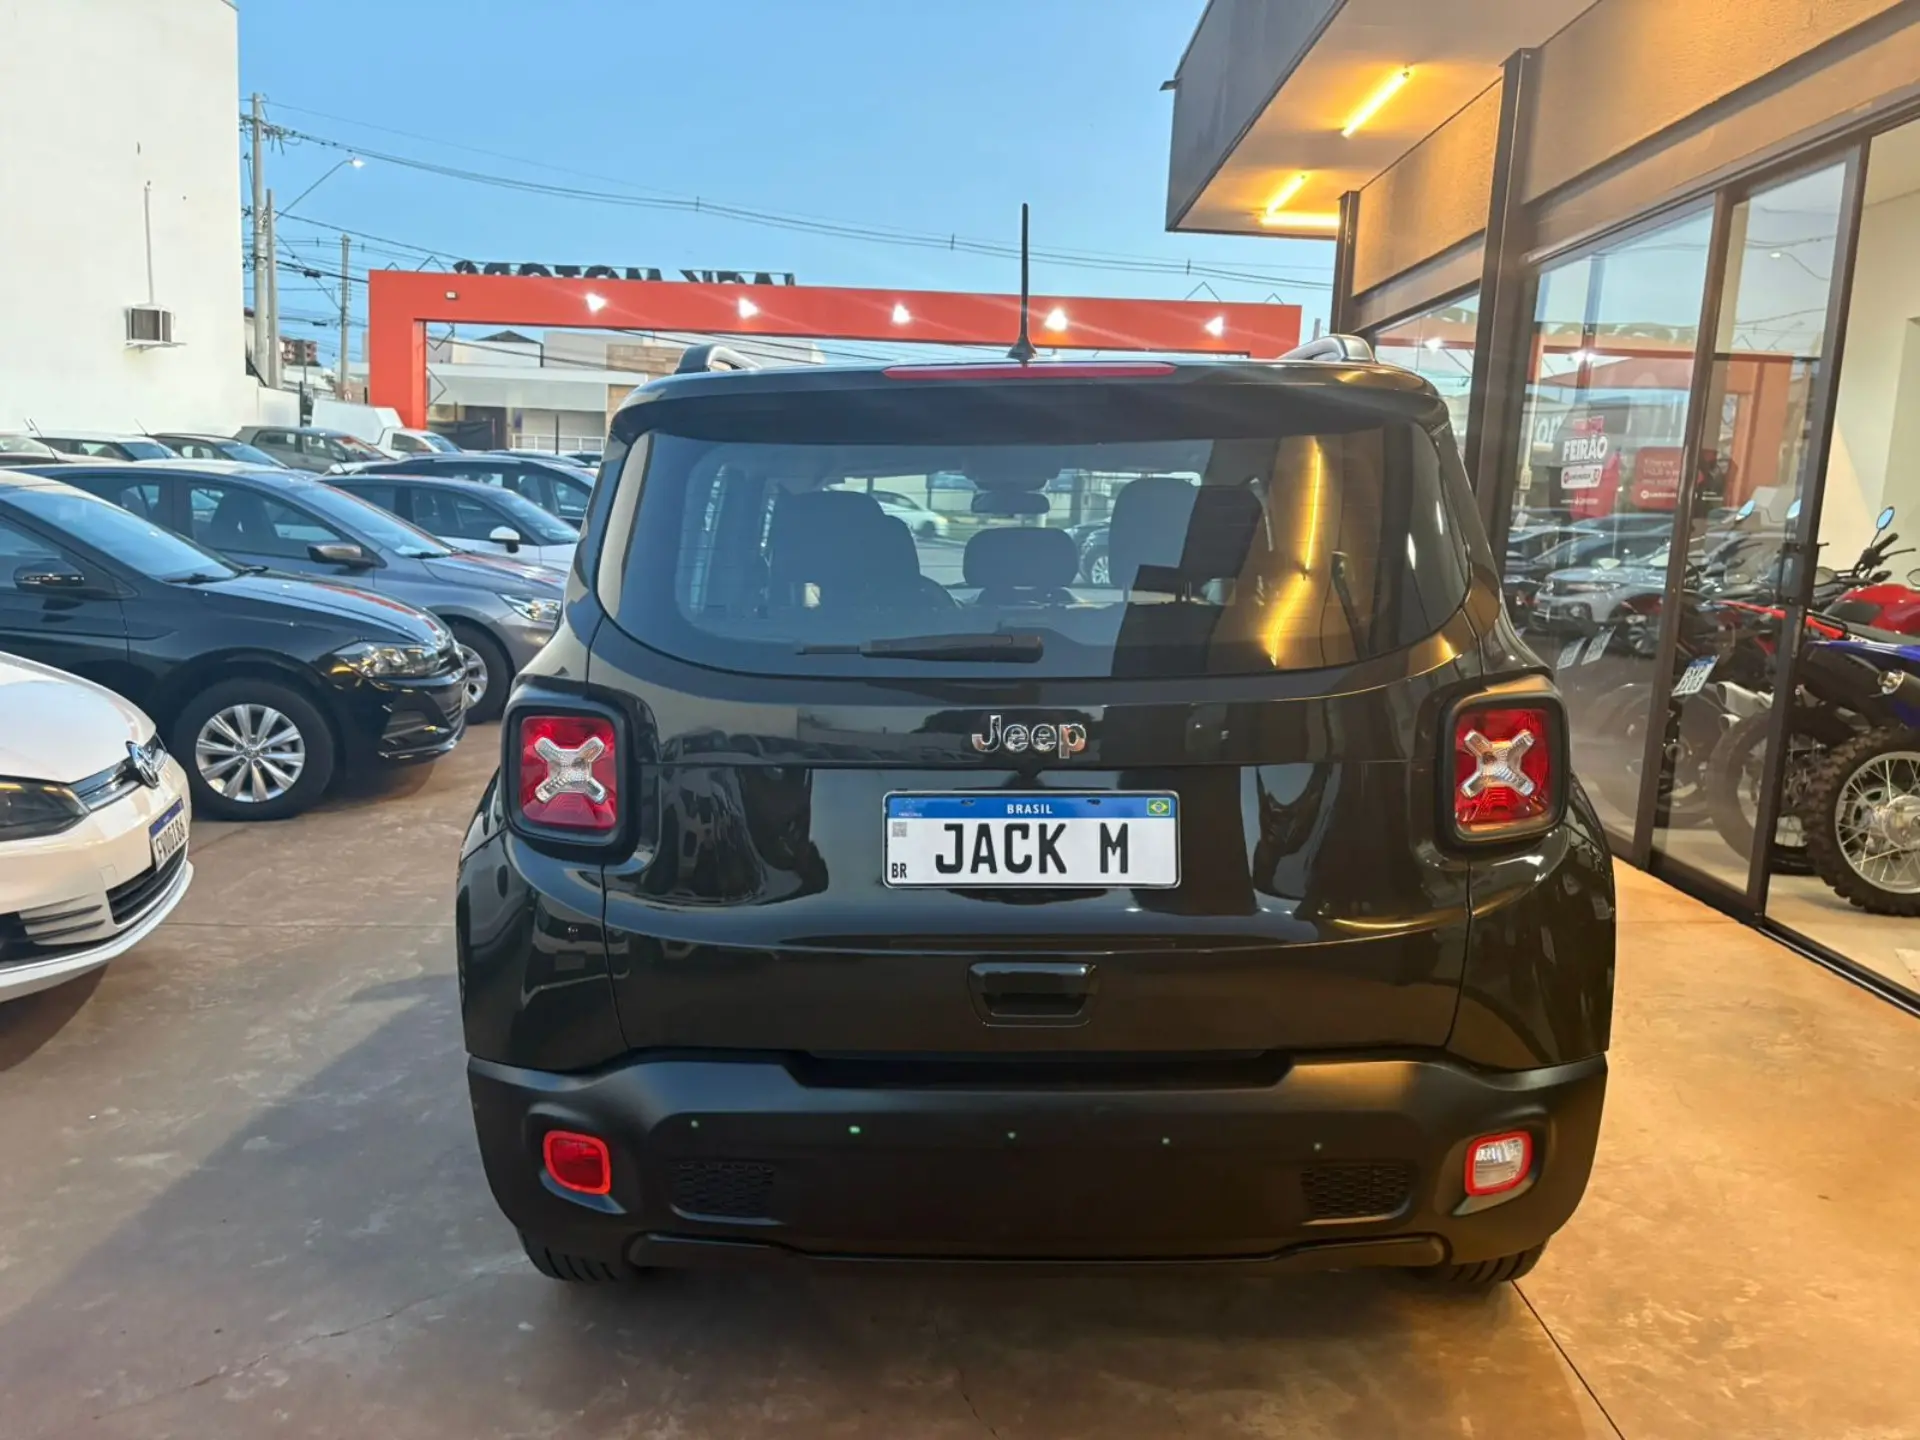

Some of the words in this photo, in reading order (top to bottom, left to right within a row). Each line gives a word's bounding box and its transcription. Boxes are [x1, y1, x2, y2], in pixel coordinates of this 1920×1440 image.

[1562, 434, 1608, 462] FEIRÃO
[971, 714, 1087, 759] Jeep
[1006, 804, 1053, 815] BRASIL
[935, 822, 1067, 875] JACK
[1099, 822, 1129, 875] M
[891, 862, 907, 879] BR
